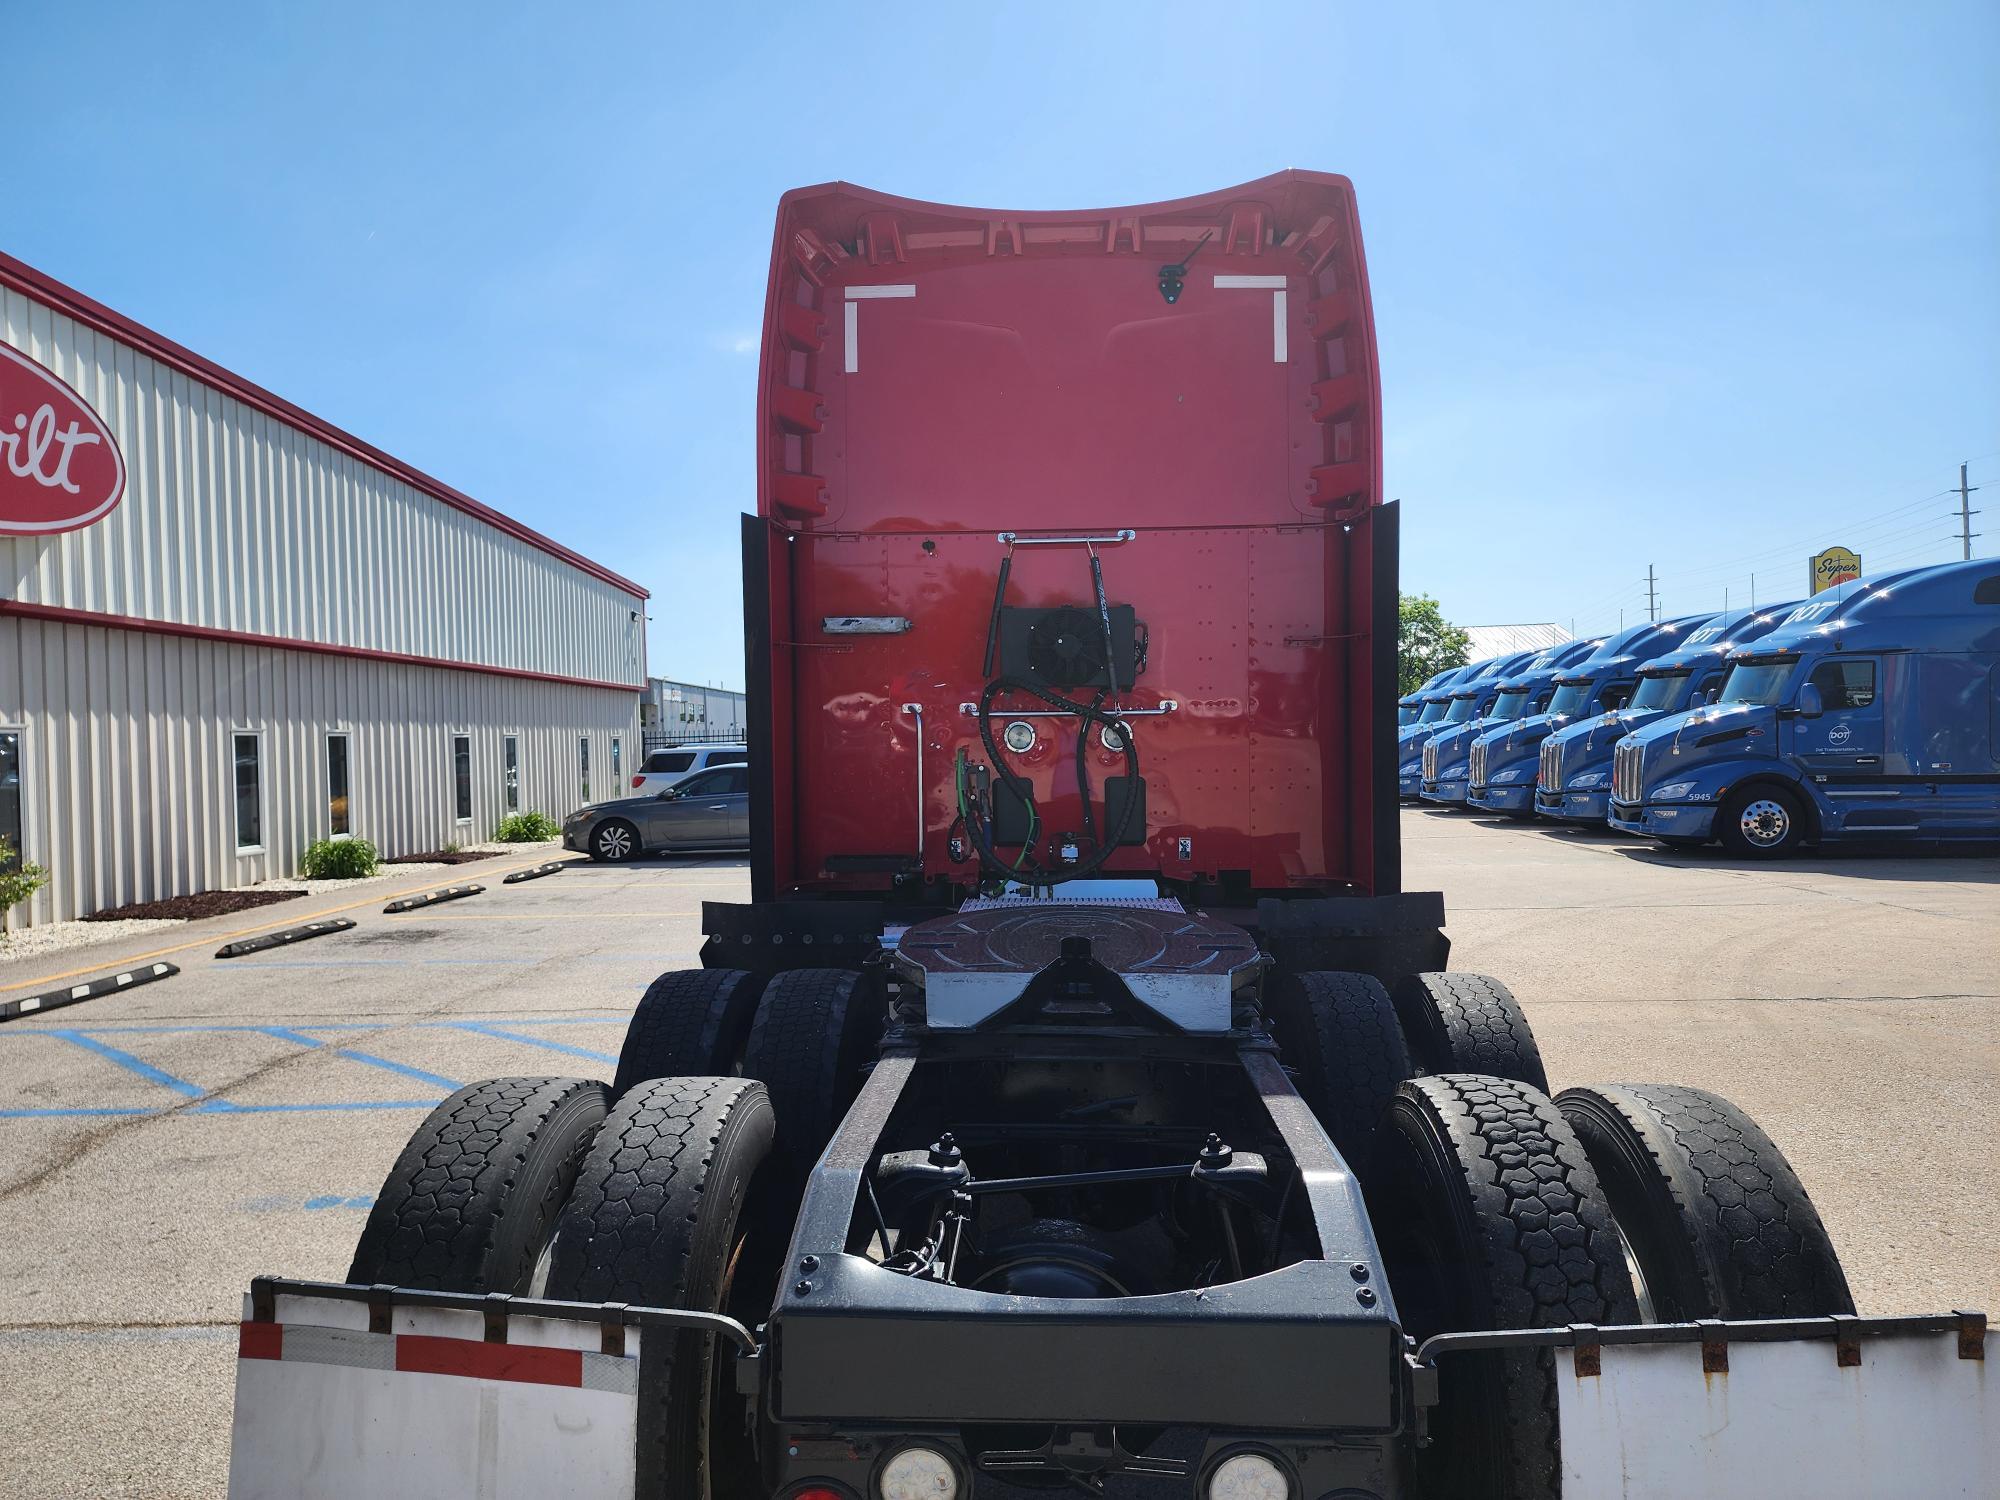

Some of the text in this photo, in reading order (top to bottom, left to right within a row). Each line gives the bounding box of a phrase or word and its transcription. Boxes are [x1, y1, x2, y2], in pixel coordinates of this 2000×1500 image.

[0, 403, 100, 494] ilt
[1817, 558, 1858, 580] Super
[1781, 601, 1841, 627] DOT
[1830, 731, 1850, 739] DOT
[1688, 793, 1711, 801] 5945
